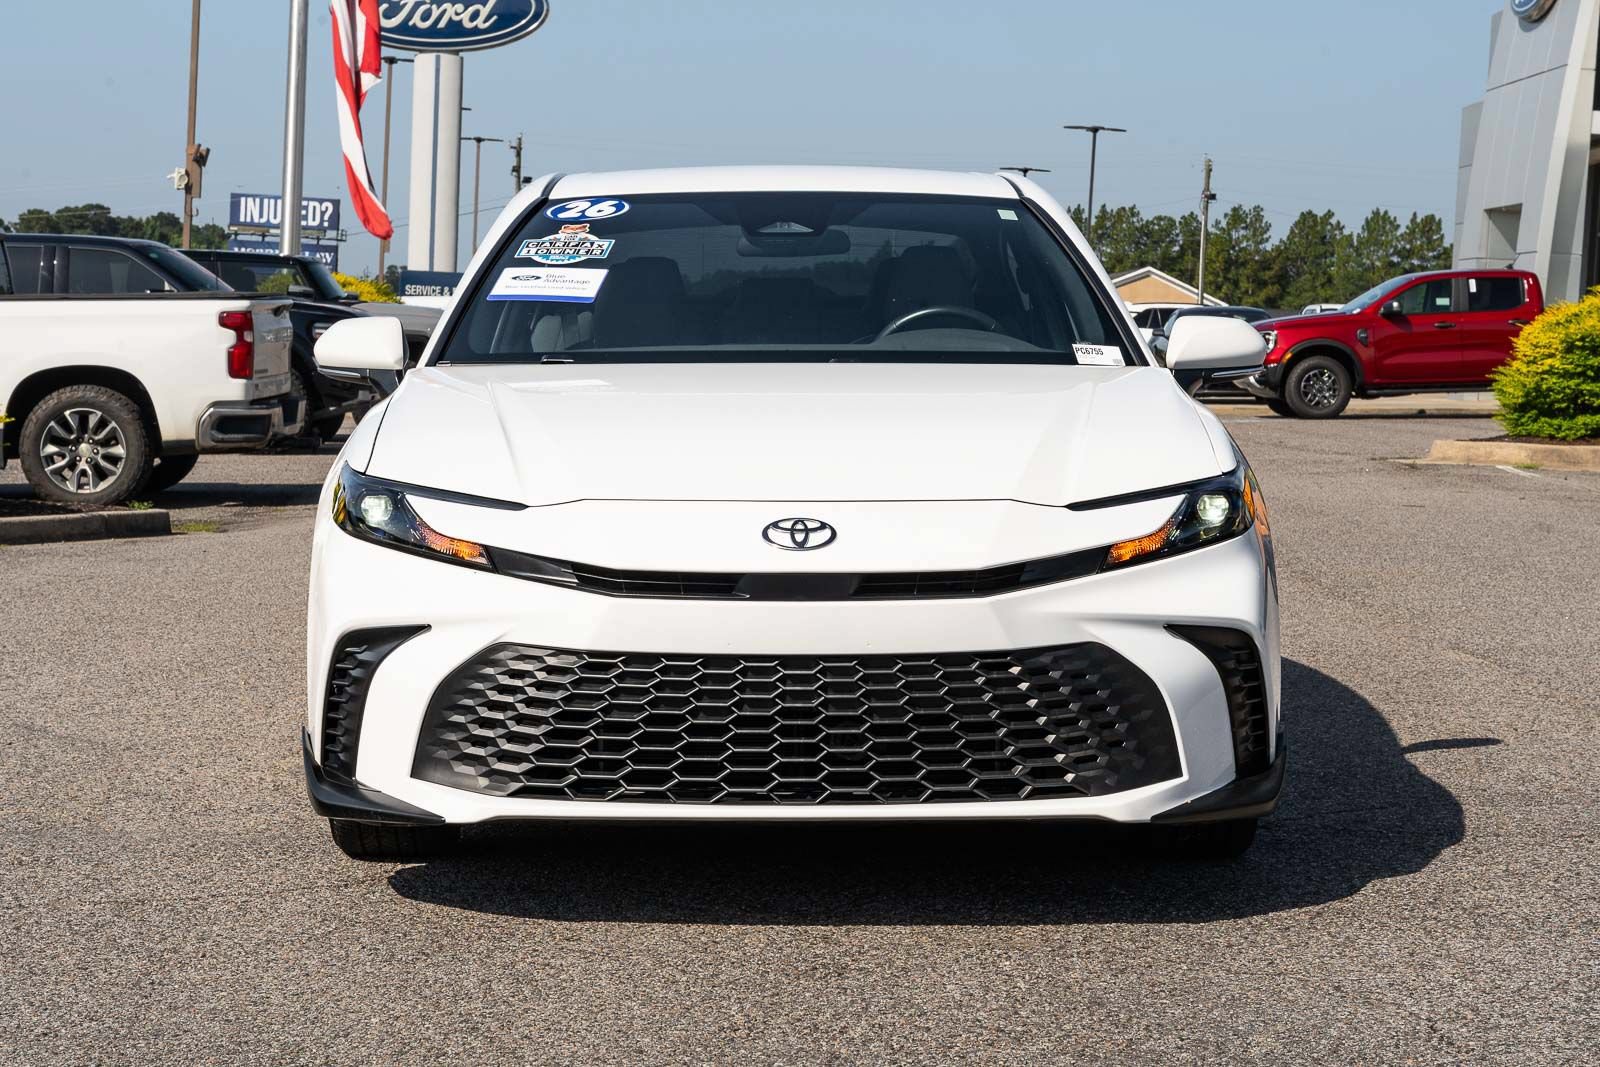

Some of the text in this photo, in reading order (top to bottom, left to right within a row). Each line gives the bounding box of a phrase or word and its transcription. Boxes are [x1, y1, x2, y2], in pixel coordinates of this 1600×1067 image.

[239, 196, 334, 228] INJUED?
[559, 201, 620, 218] 26
[405, 284, 442, 296] SERVICE
[443, 286, 450, 296] &
[1074, 347, 1104, 355] PC6755
